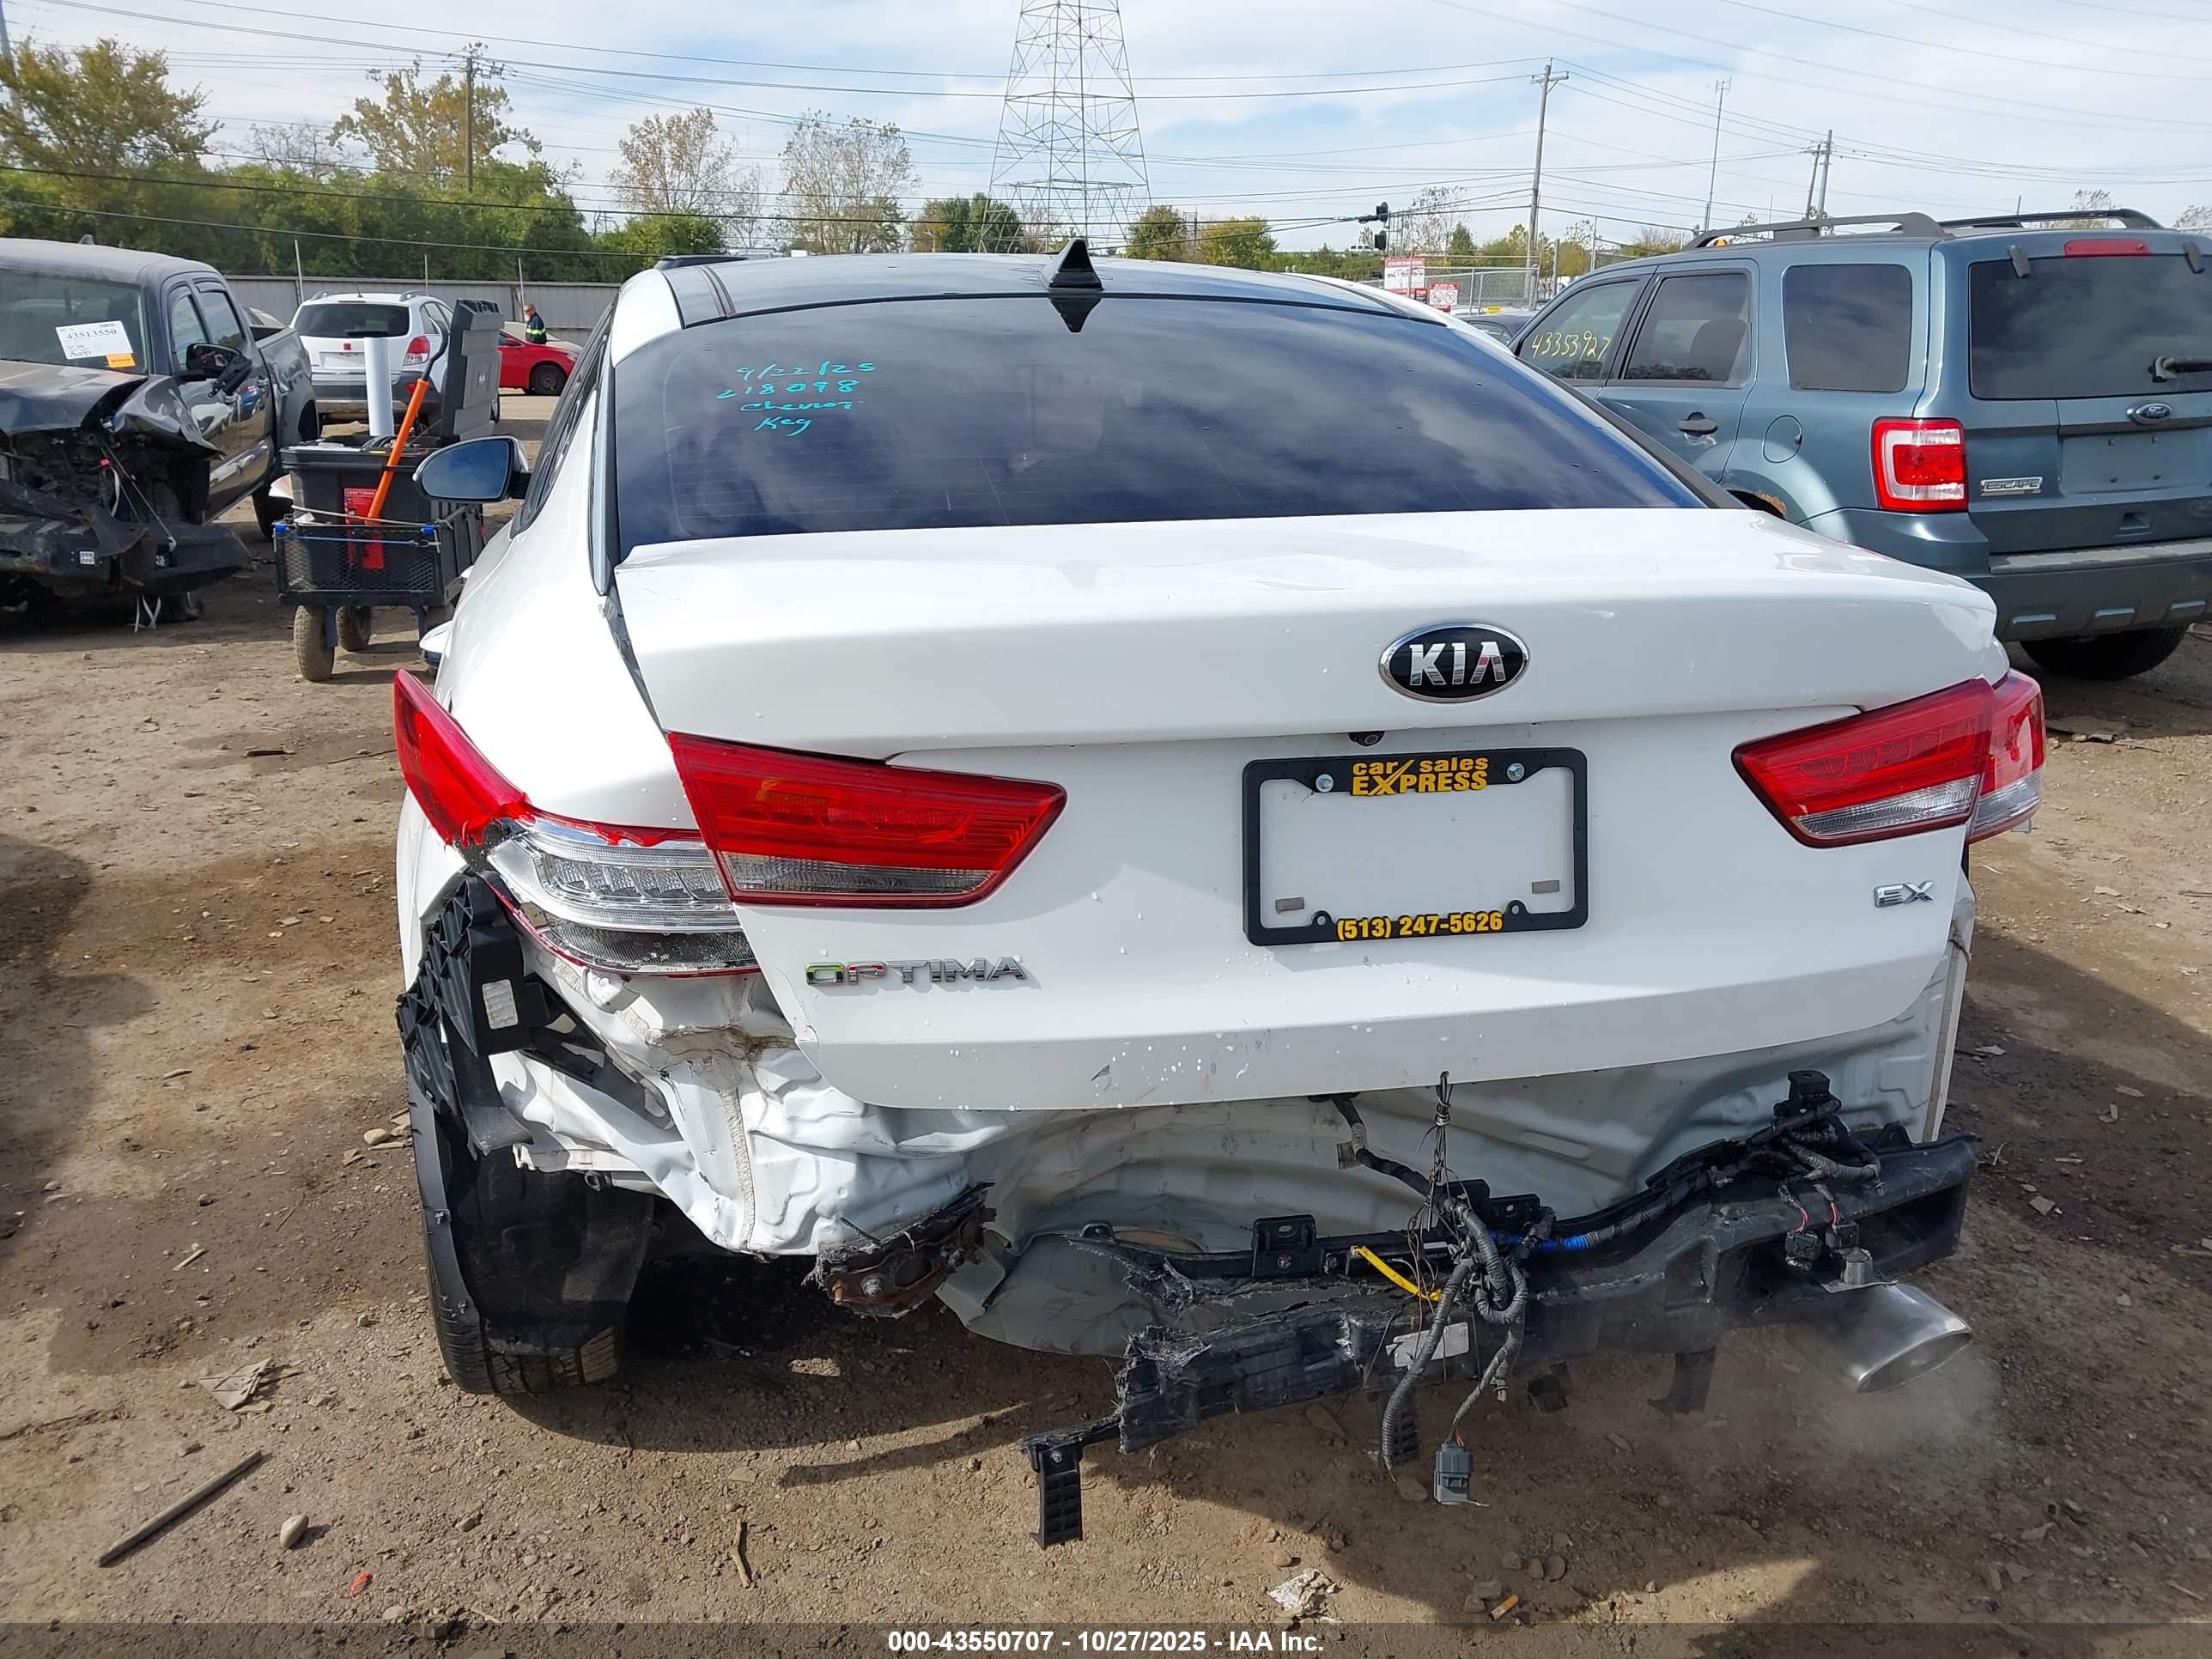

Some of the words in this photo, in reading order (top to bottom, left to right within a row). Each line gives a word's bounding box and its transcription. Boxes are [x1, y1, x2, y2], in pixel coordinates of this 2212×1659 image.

[1532, 331, 1611, 361] 43353927
[1983, 479, 2040, 490] ESCAPE
[1409, 641, 1506, 685] KIA
[1352, 761, 1399, 775] car
[1419, 757, 1489, 773] sales
[1352, 770, 1488, 796] EXPRESS
[1875, 880, 1934, 908] EX
[1337, 918, 1392, 940] (513)
[1400, 912, 1503, 935] 247-5626
[805, 957, 1029, 986] OPTIMA
